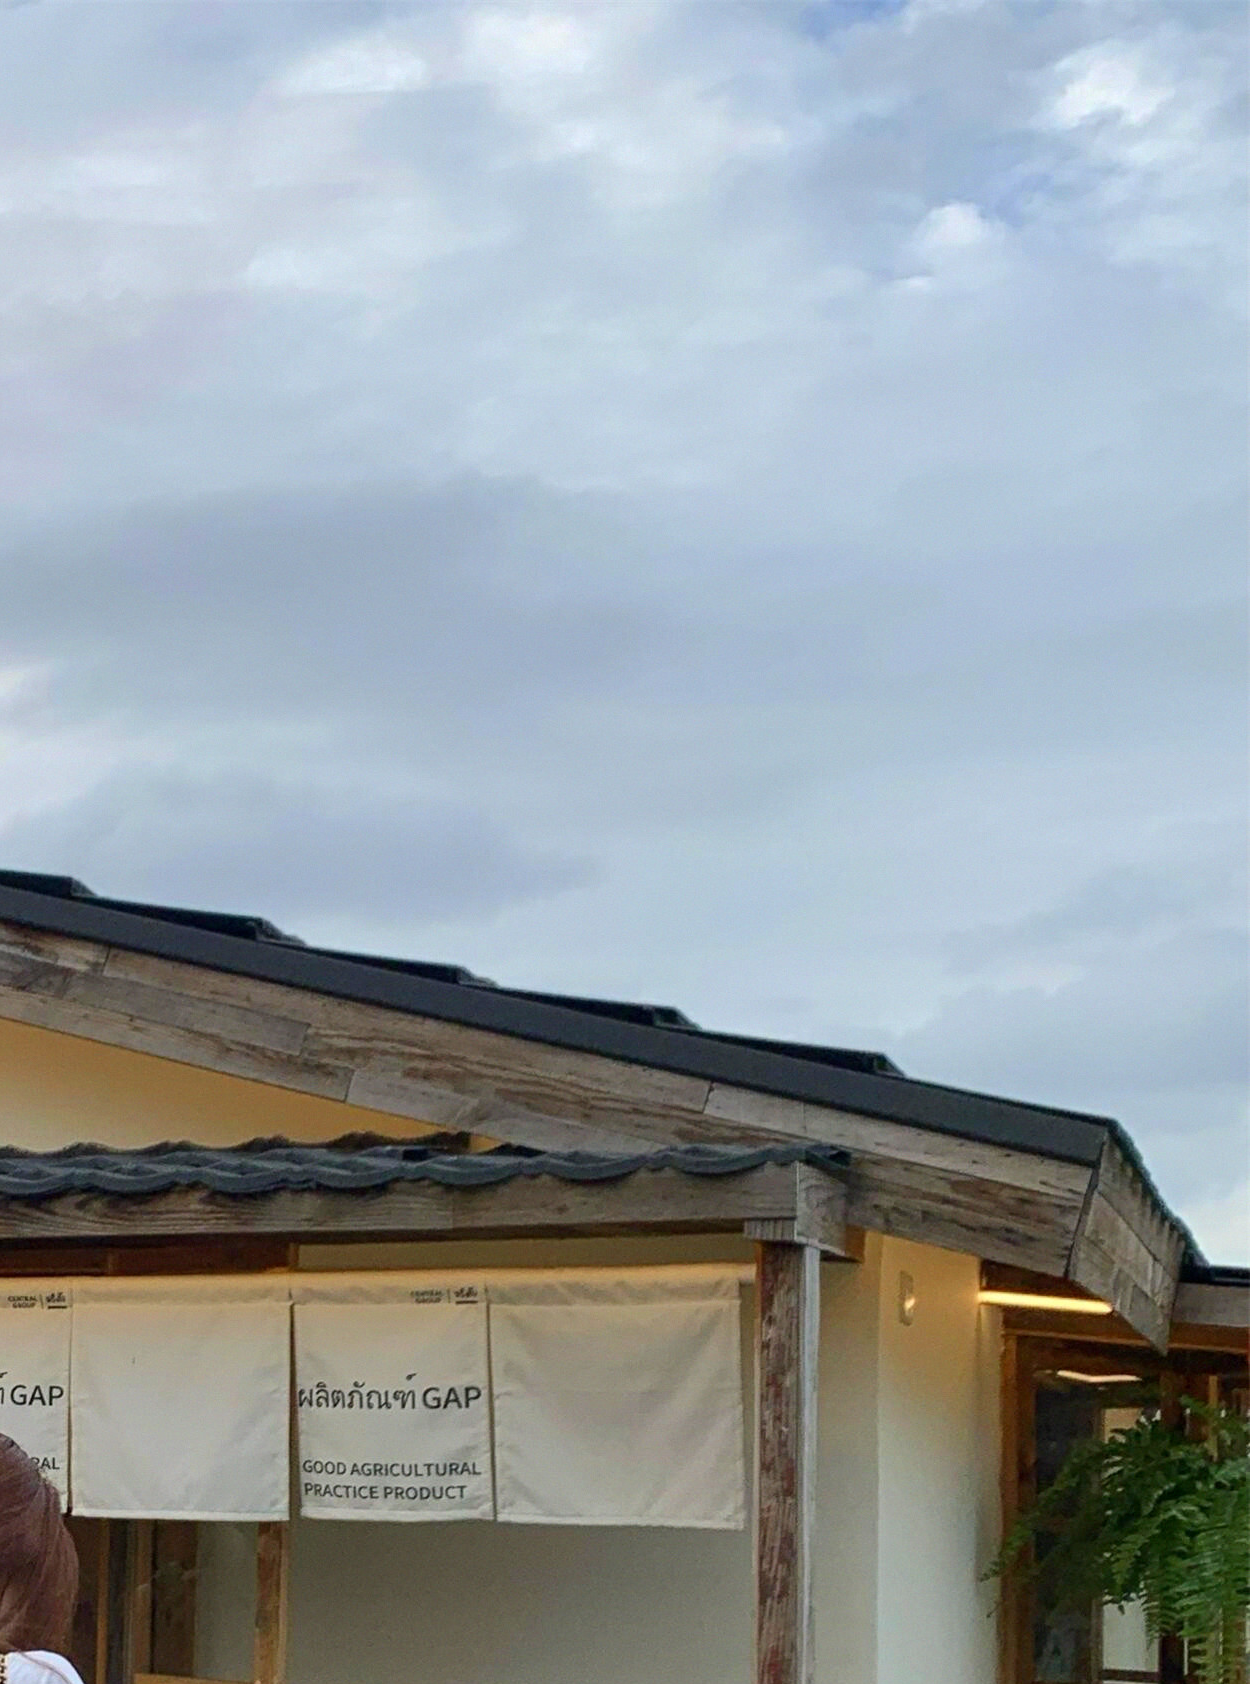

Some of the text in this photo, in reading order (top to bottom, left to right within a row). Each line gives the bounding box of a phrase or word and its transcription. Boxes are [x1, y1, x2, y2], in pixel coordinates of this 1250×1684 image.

[10, 1385, 64, 1406] GAP
[298, 1373, 482, 1410] ผลิตภัณฑ์ GAP
[303, 1459, 482, 1477] GOOD AGRICULTURAL
[304, 1483, 467, 1500] PRACTICE PRODUCT
